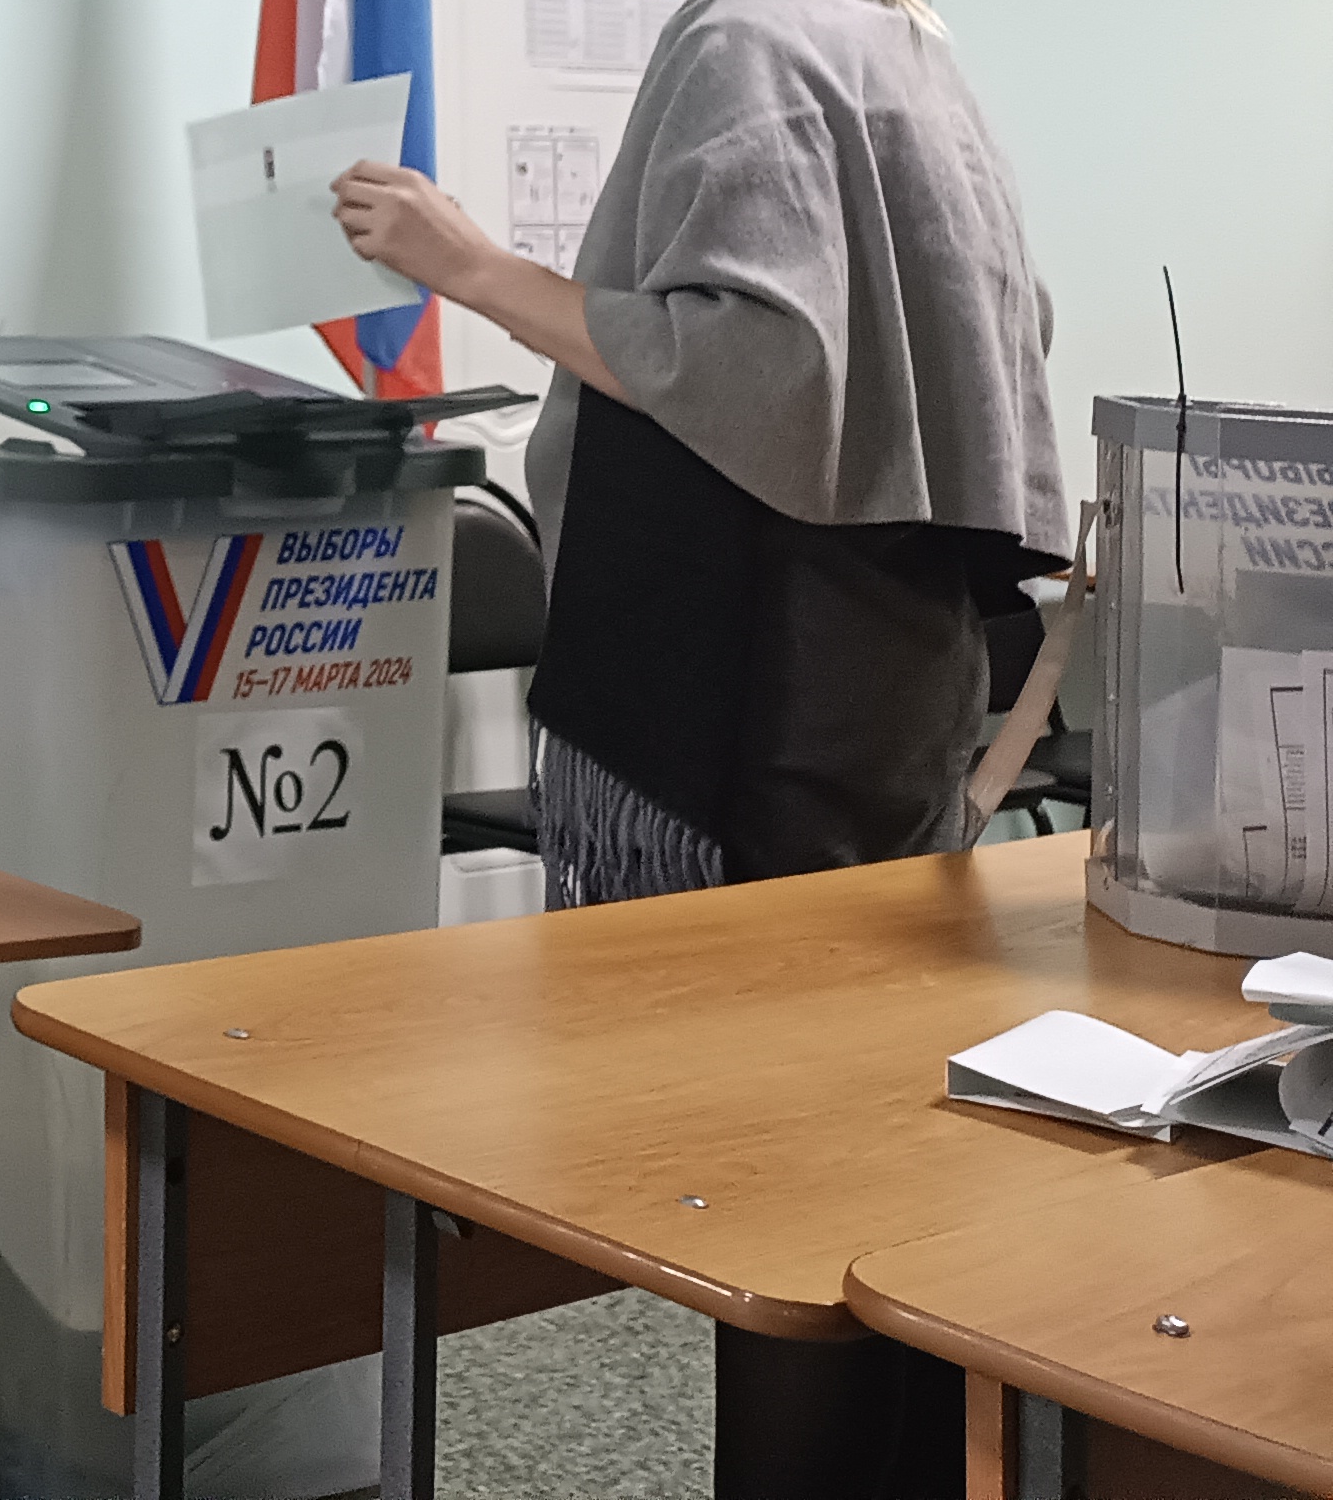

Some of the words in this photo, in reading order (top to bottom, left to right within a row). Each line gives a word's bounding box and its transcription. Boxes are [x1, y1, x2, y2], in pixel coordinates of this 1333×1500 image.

[276, 525, 405, 566] ВЫБОРЫ
[260, 566, 438, 612] ПРЕЗИДЕНТА
[244, 618, 363, 660] РОССИИ
[292, 659, 362, 694] МАРТА
[363, 656, 414, 690] 2024
